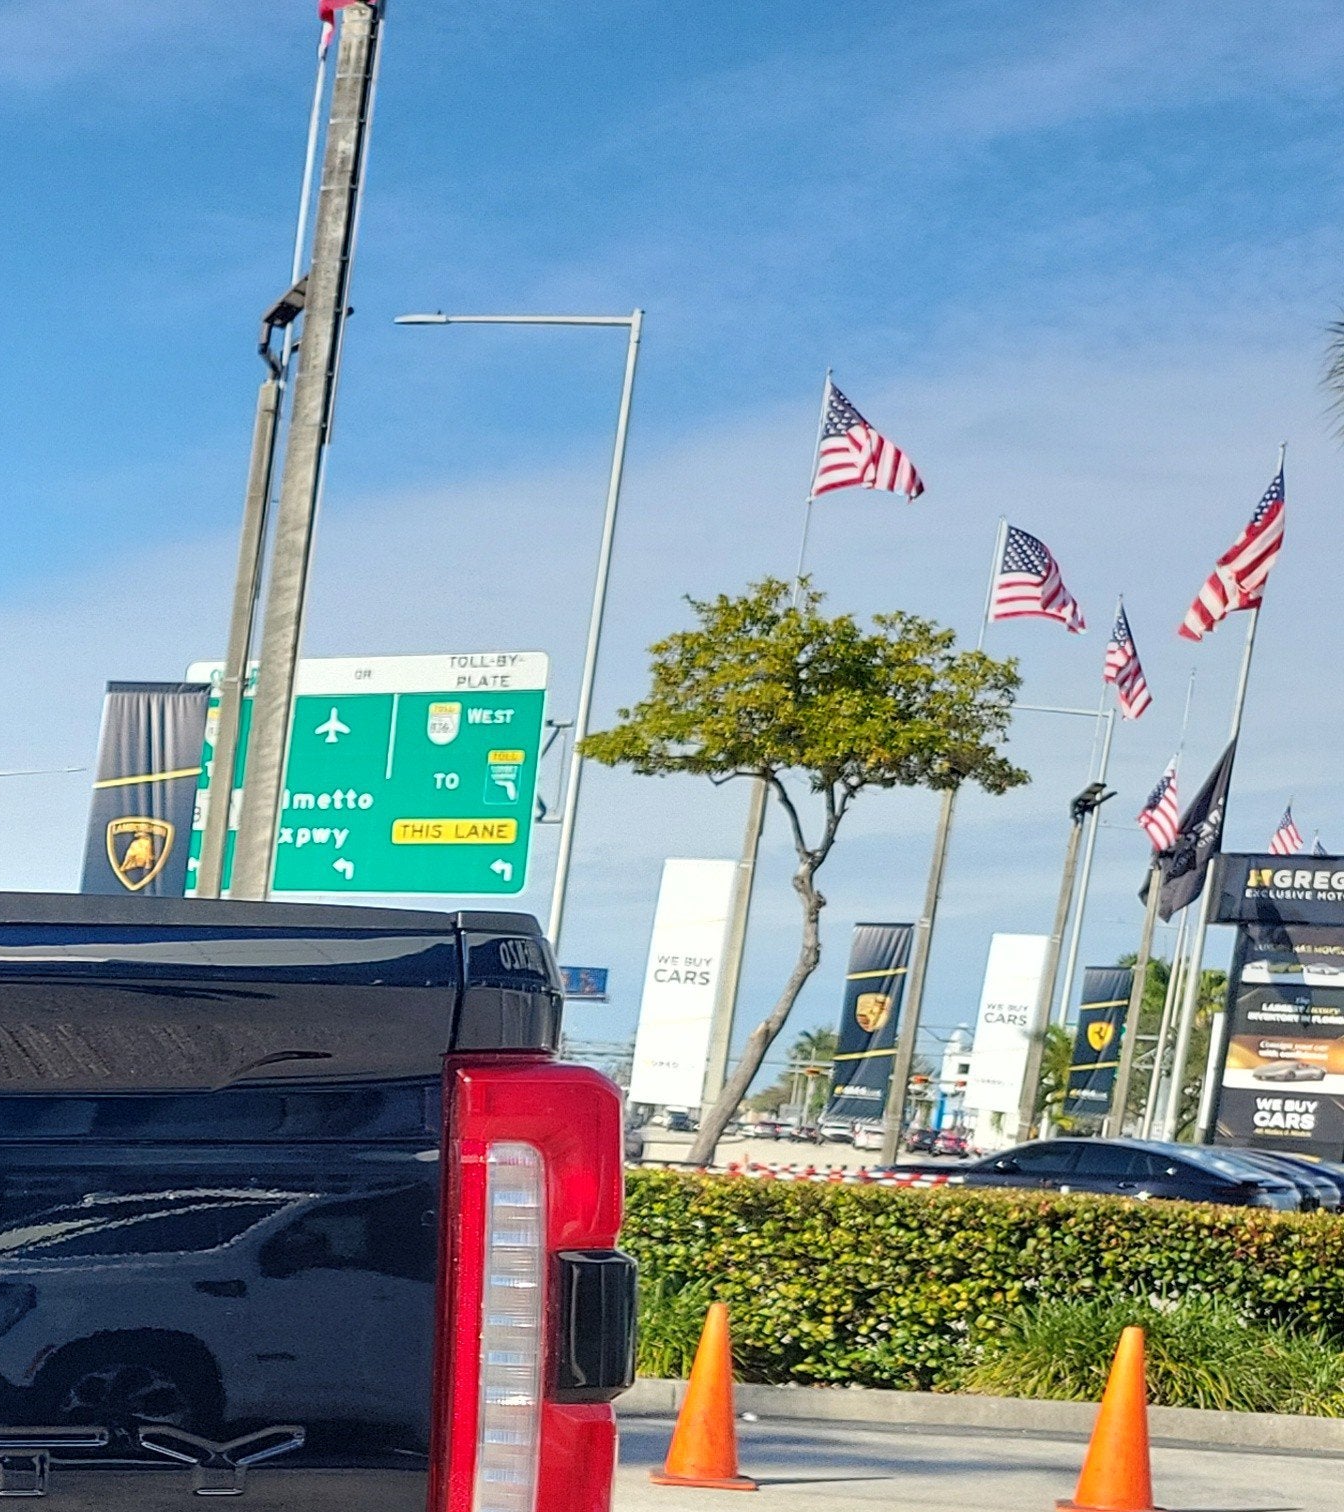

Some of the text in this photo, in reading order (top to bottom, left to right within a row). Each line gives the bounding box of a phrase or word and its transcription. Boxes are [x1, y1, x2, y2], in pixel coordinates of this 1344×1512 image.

[456, 674, 511, 689] PLATE
[467, 708, 515, 724] WEST
[433, 772, 460, 790] TO
[282, 788, 375, 810] lmetto
[278, 827, 351, 850] xpwy
[400, 823, 509, 839] THIS LANE
[1245, 888, 1344, 901] EXCLUSIVE MOT
[657, 955, 713, 968] WE BUY
[653, 968, 712, 986] CARS
[986, 1002, 1004, 1011] WE
[984, 1012, 1028, 1026] CARS
[1256, 1098, 1318, 1113] WE BUY
[1253, 1111, 1315, 1130] CARS
